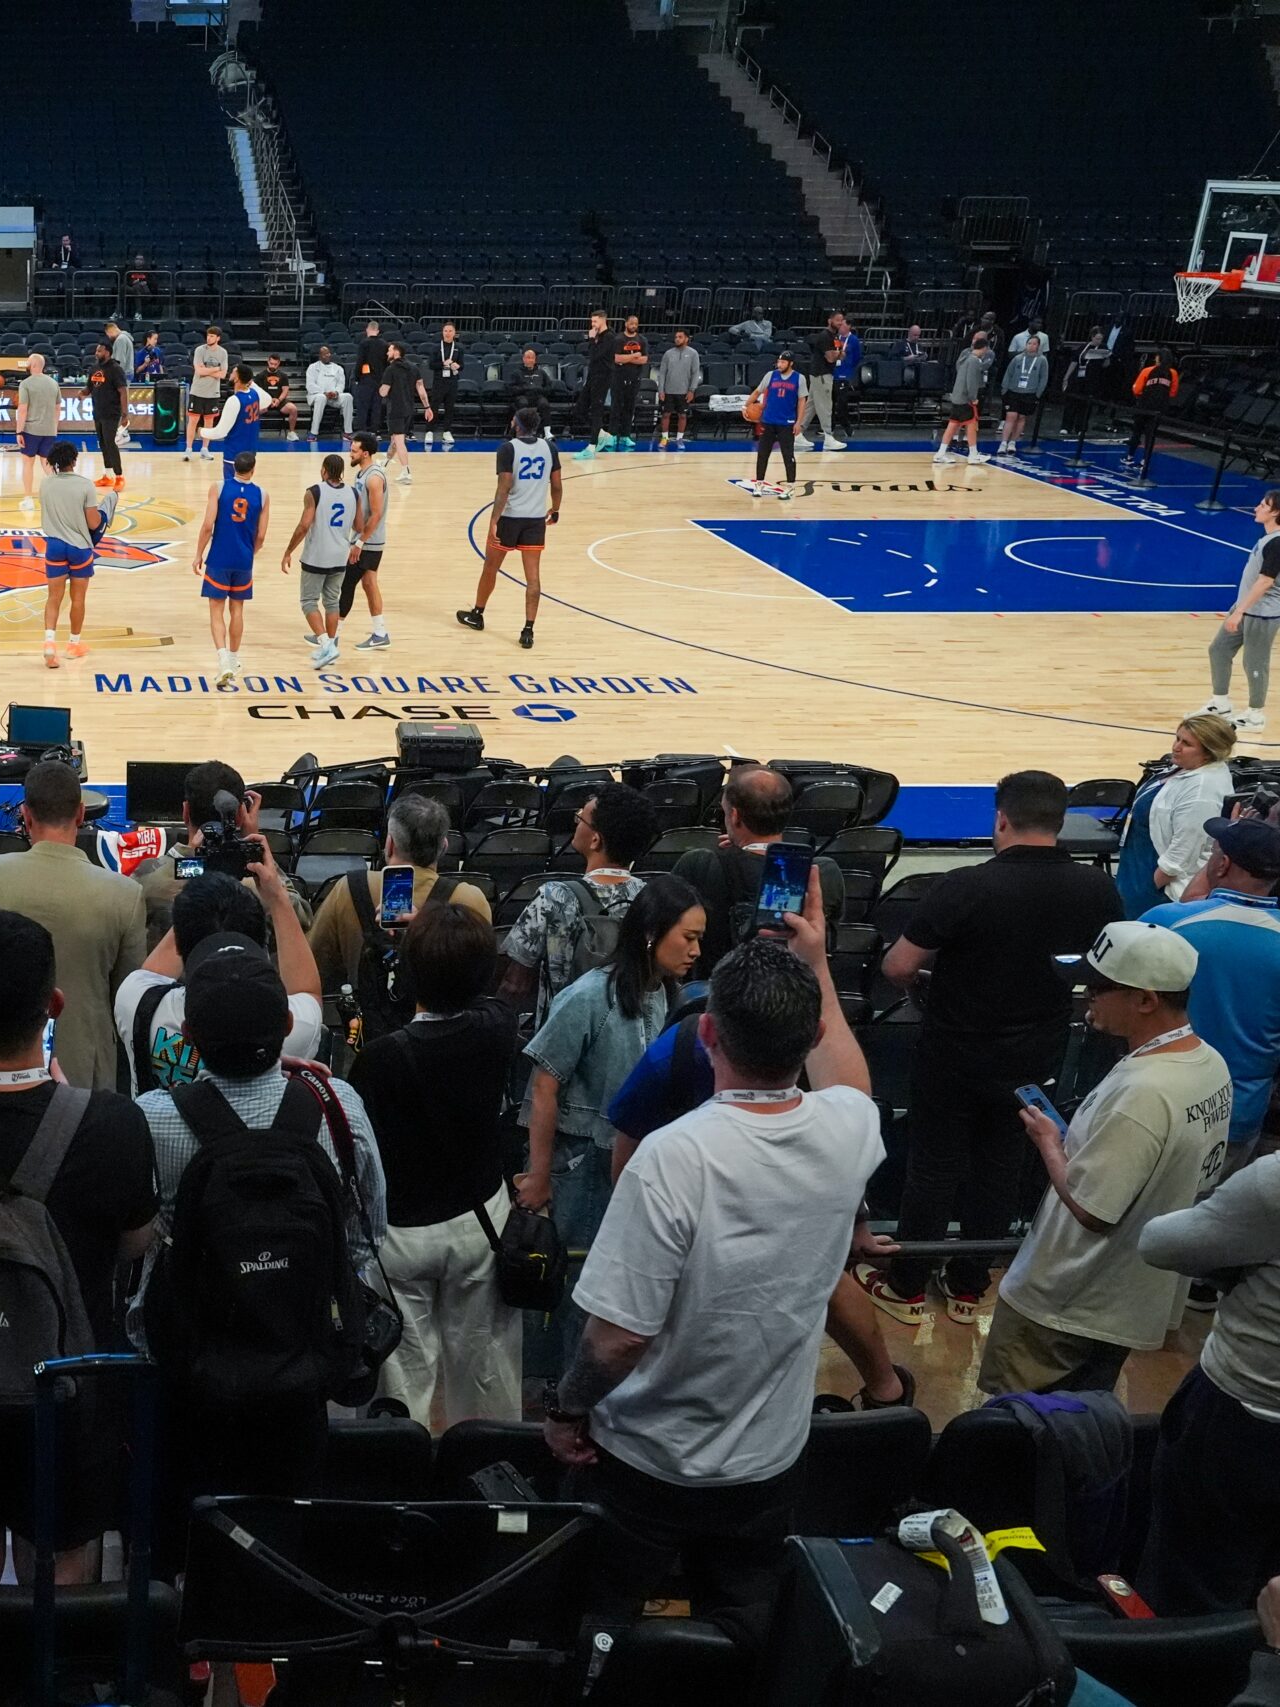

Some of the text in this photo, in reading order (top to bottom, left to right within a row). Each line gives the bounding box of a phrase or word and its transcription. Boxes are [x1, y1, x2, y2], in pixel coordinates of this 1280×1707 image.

[245, 401, 260, 425] 32
[518, 456, 546, 480] 23
[231, 497, 249, 523] 9
[1076, 484, 1186, 517] ULTRA
[329, 502, 345, 527] 2
[317, 673, 500, 694] SQUARE
[508, 673, 698, 694] GARDEN
[248, 704, 500, 720] CHASE
[136, 828, 157, 845] NBA
[122, 844, 157, 859] ESPN
[1091, 931, 1113, 963] LT
[300, 1070, 331, 1103] Canon
[1185, 1080, 1233, 1124] KNOW YOU
[239, 1257, 289, 1274] SPALDING
[954, 1303, 975, 1316] NY
